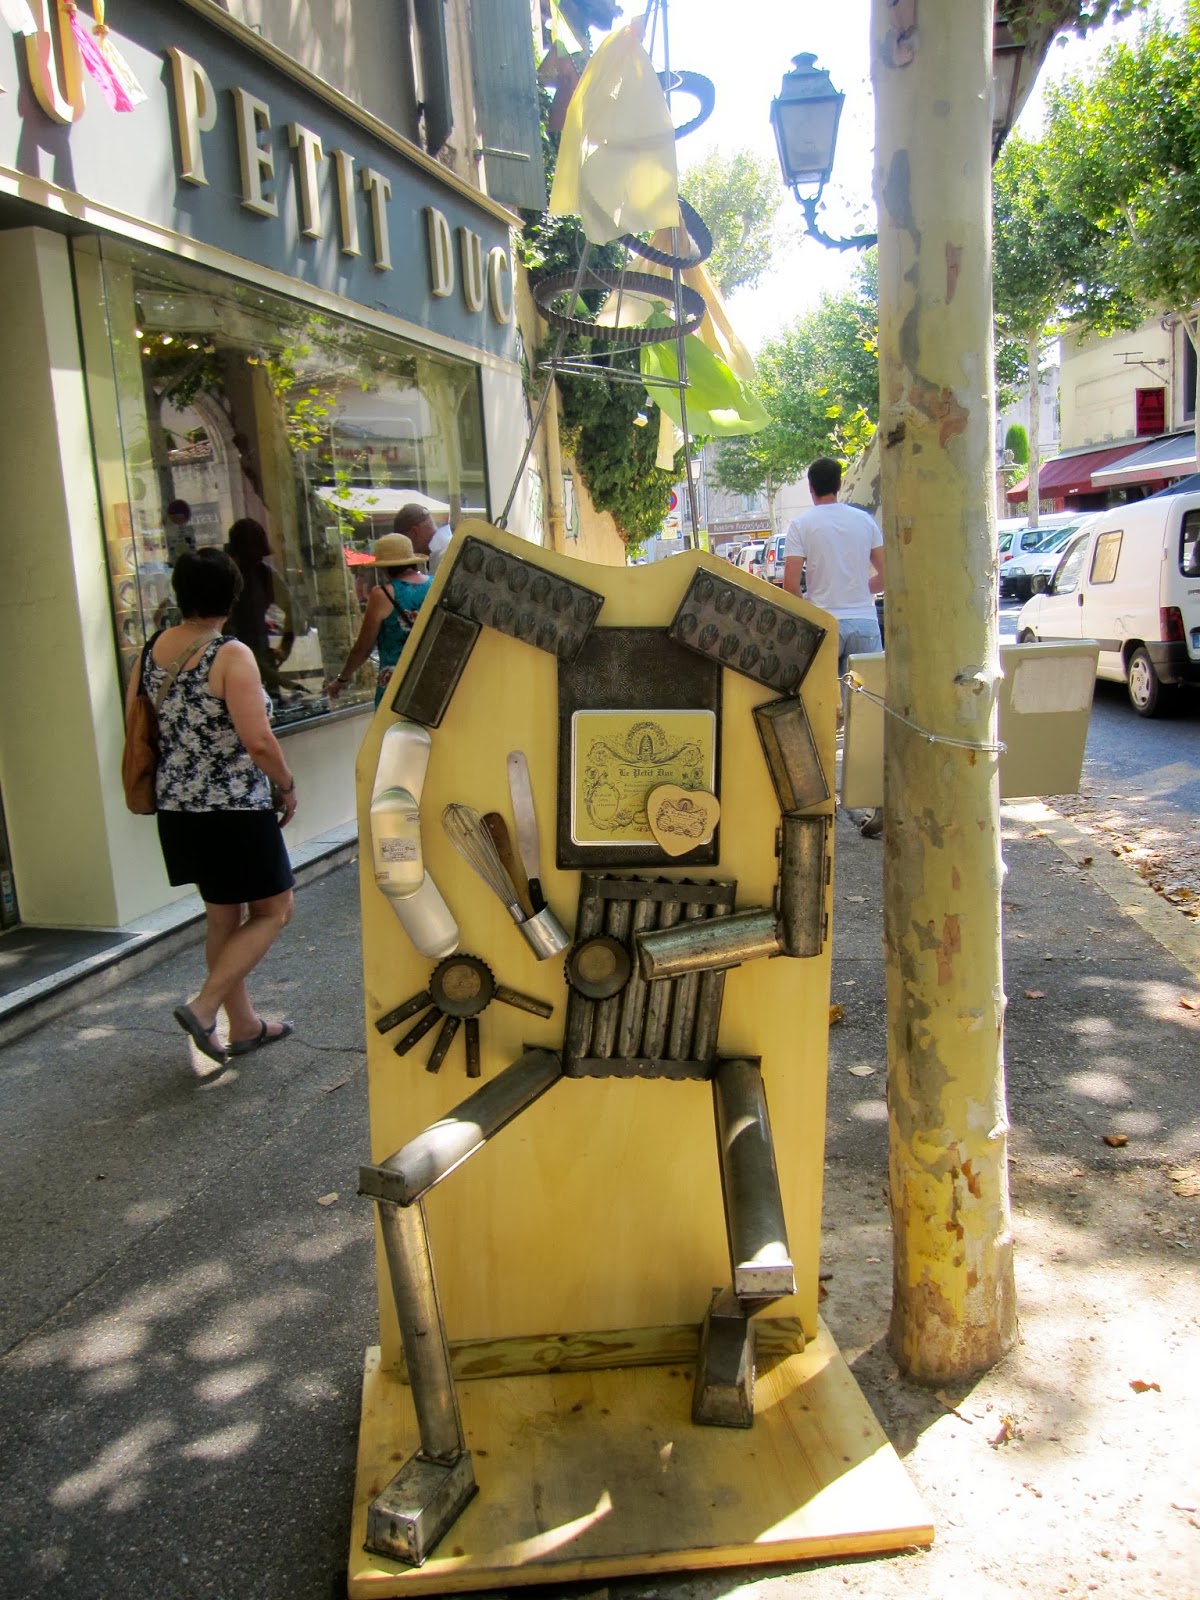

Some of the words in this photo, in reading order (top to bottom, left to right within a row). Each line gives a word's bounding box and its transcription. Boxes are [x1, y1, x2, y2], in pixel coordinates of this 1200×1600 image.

[167, 47, 393, 270] PETIT
[425, 206, 512, 324] DUC
[619, 769, 630, 777] Le
[633, 769, 653, 778] Petit
[657, 769, 673, 777] Duc
